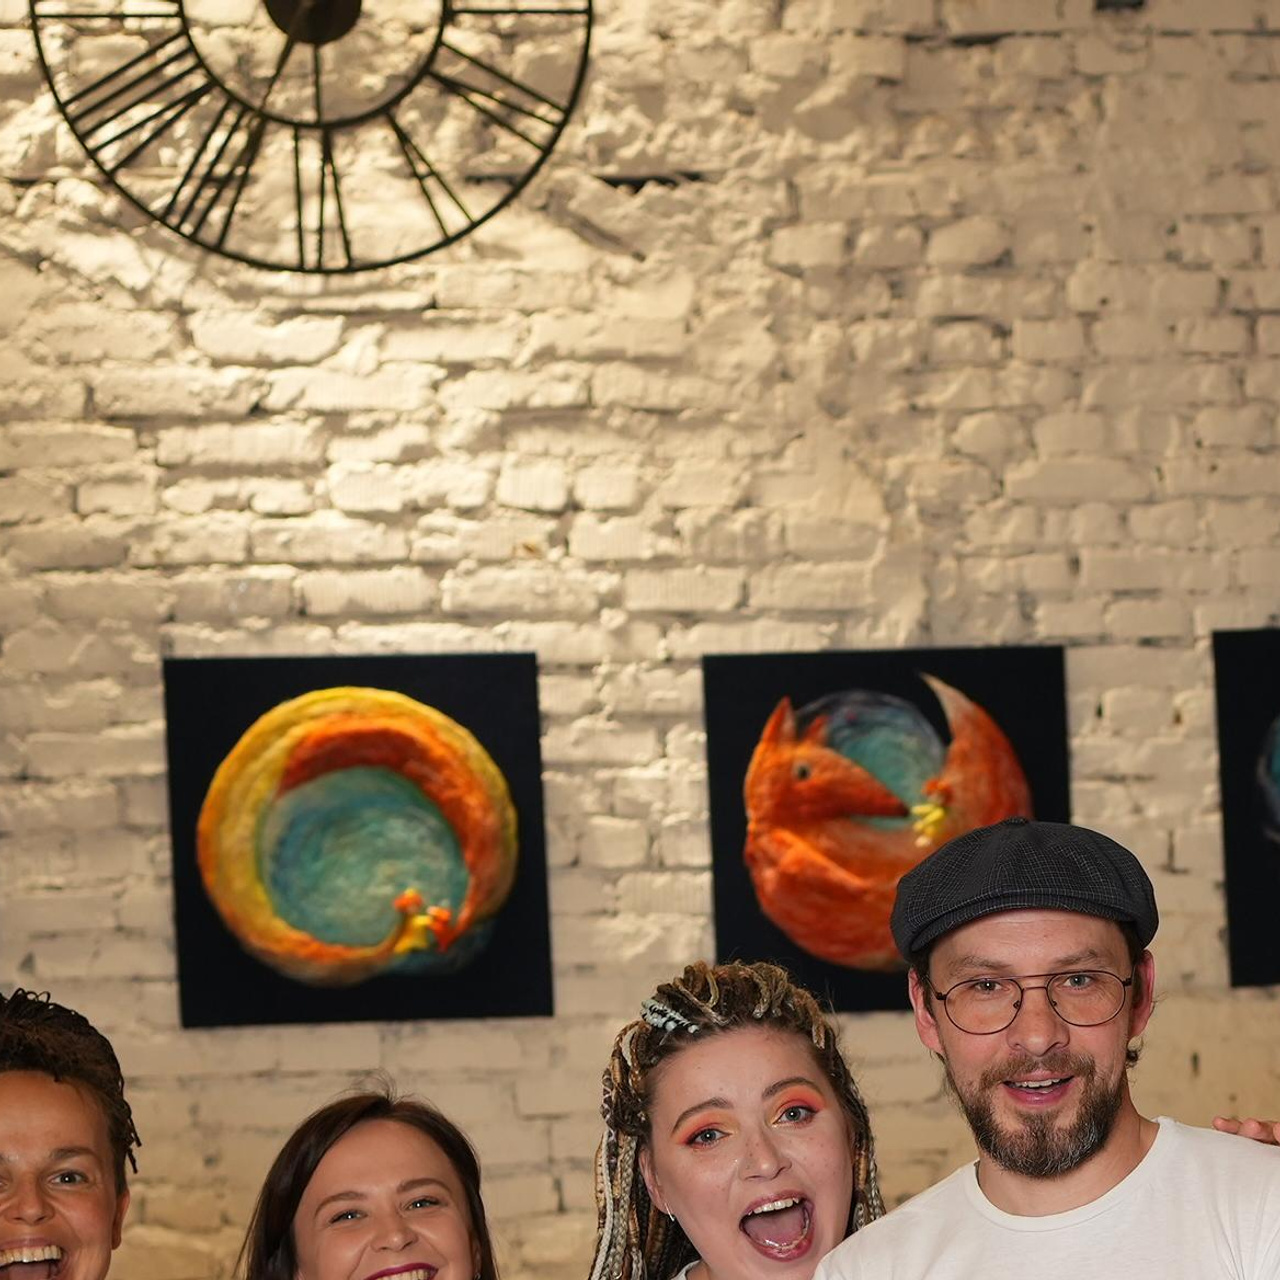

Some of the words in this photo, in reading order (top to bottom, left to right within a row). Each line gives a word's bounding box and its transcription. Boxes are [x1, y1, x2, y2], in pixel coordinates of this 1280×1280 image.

[59, 32, 215, 178] VIII
[386, 108, 476, 239] V
[293, 125, 353, 270] VI
